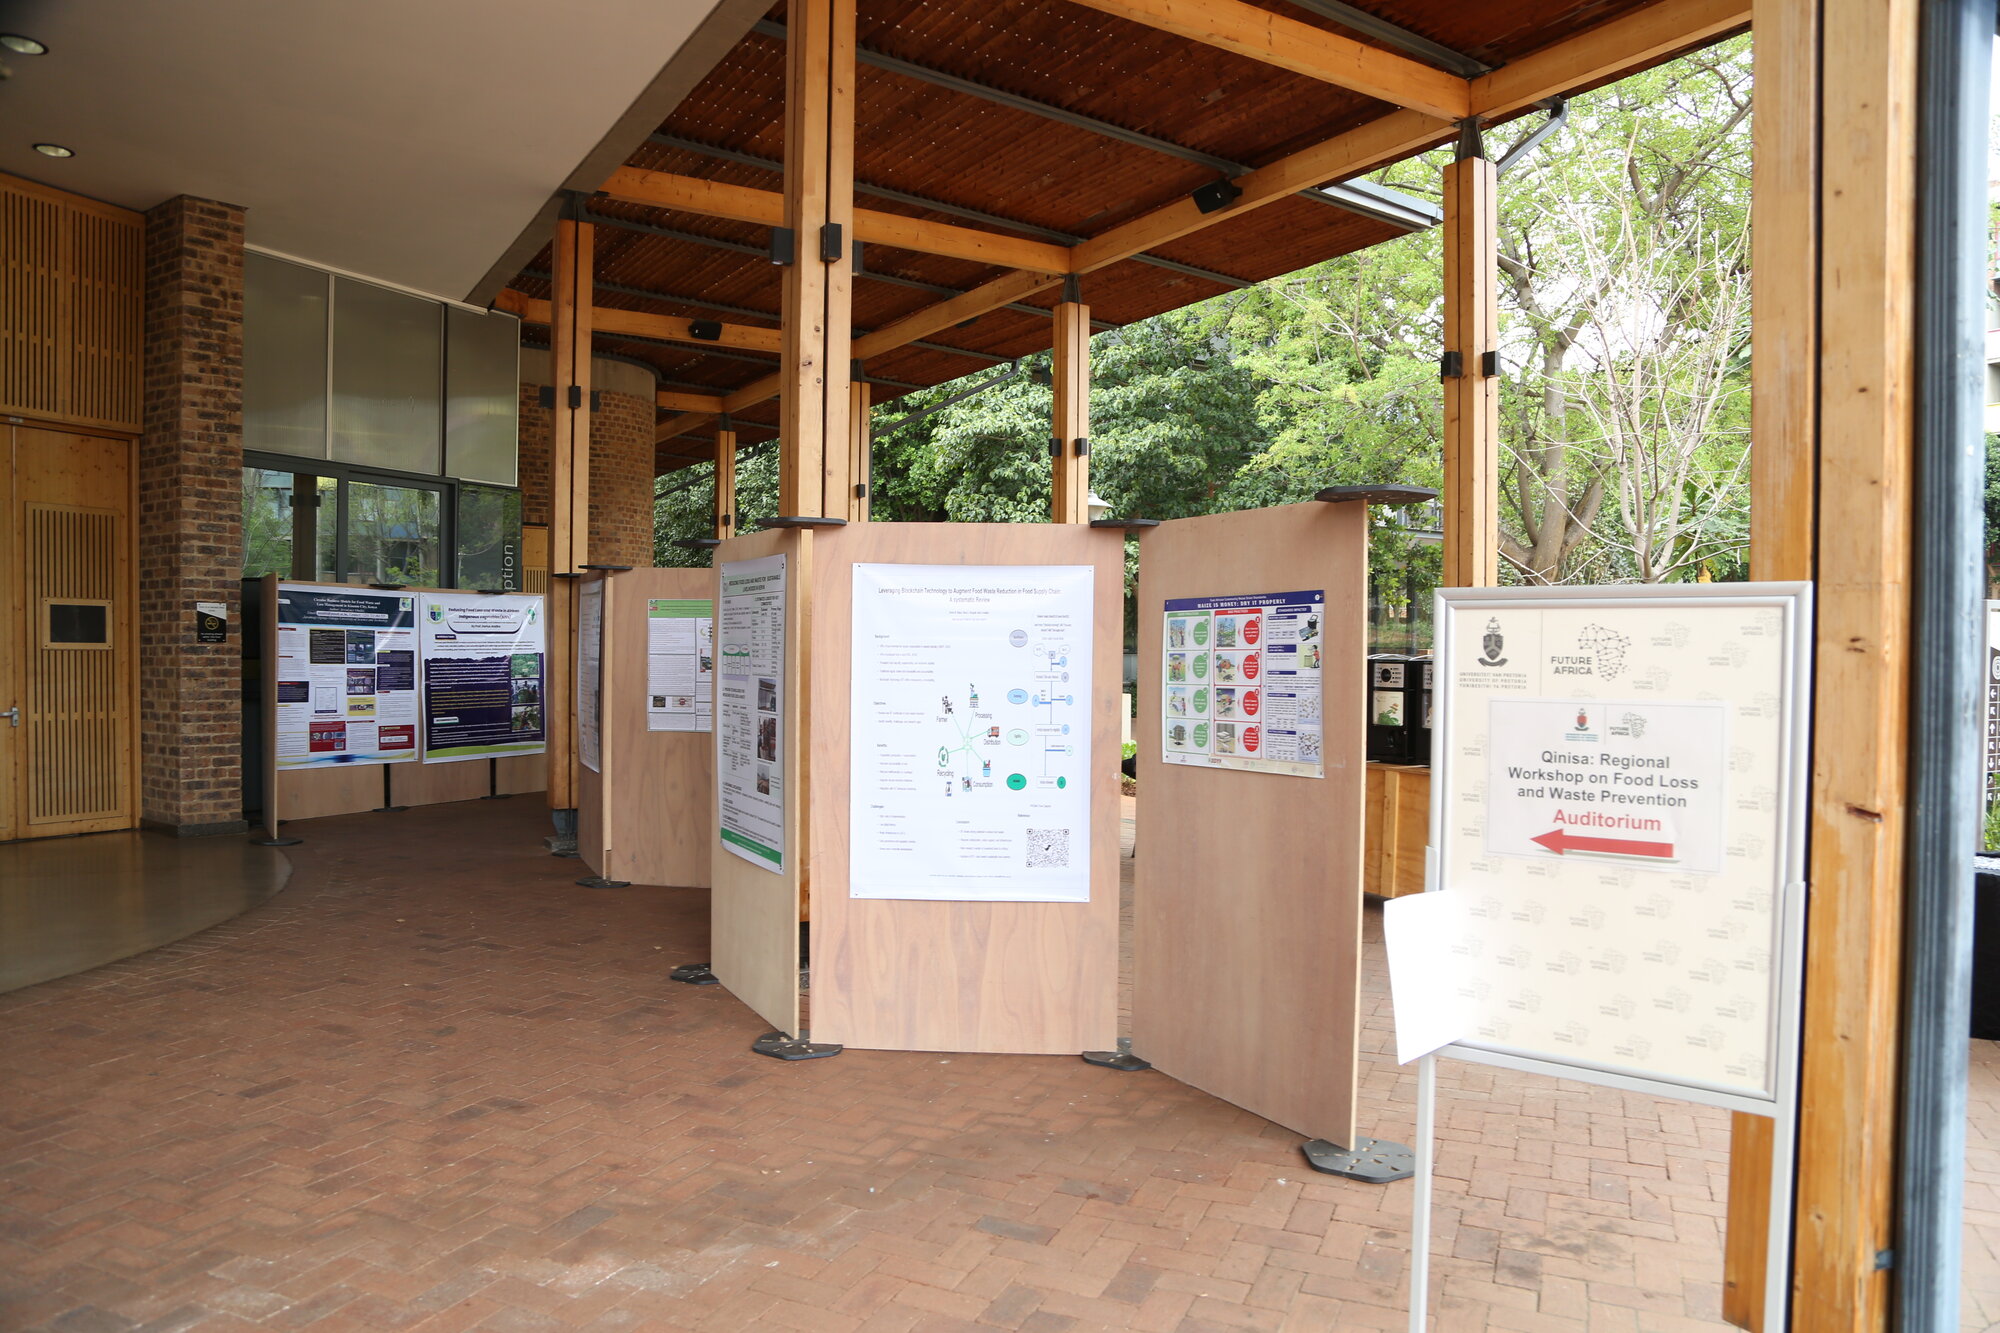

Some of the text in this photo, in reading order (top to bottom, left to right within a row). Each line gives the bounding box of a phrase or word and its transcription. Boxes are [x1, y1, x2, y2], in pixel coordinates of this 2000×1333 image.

[501, 544, 516, 590] ption
[1551, 656, 1592, 665] FUTURE
[1553, 666, 1593, 675] AFRICA
[1542, 750, 1670, 769] Qinisa: Regional
[1508, 767, 1699, 789] Workshop on Food Loss
[1518, 787, 1687, 807] and Waste Prevention
[1553, 809, 1661, 831] Auditorium
